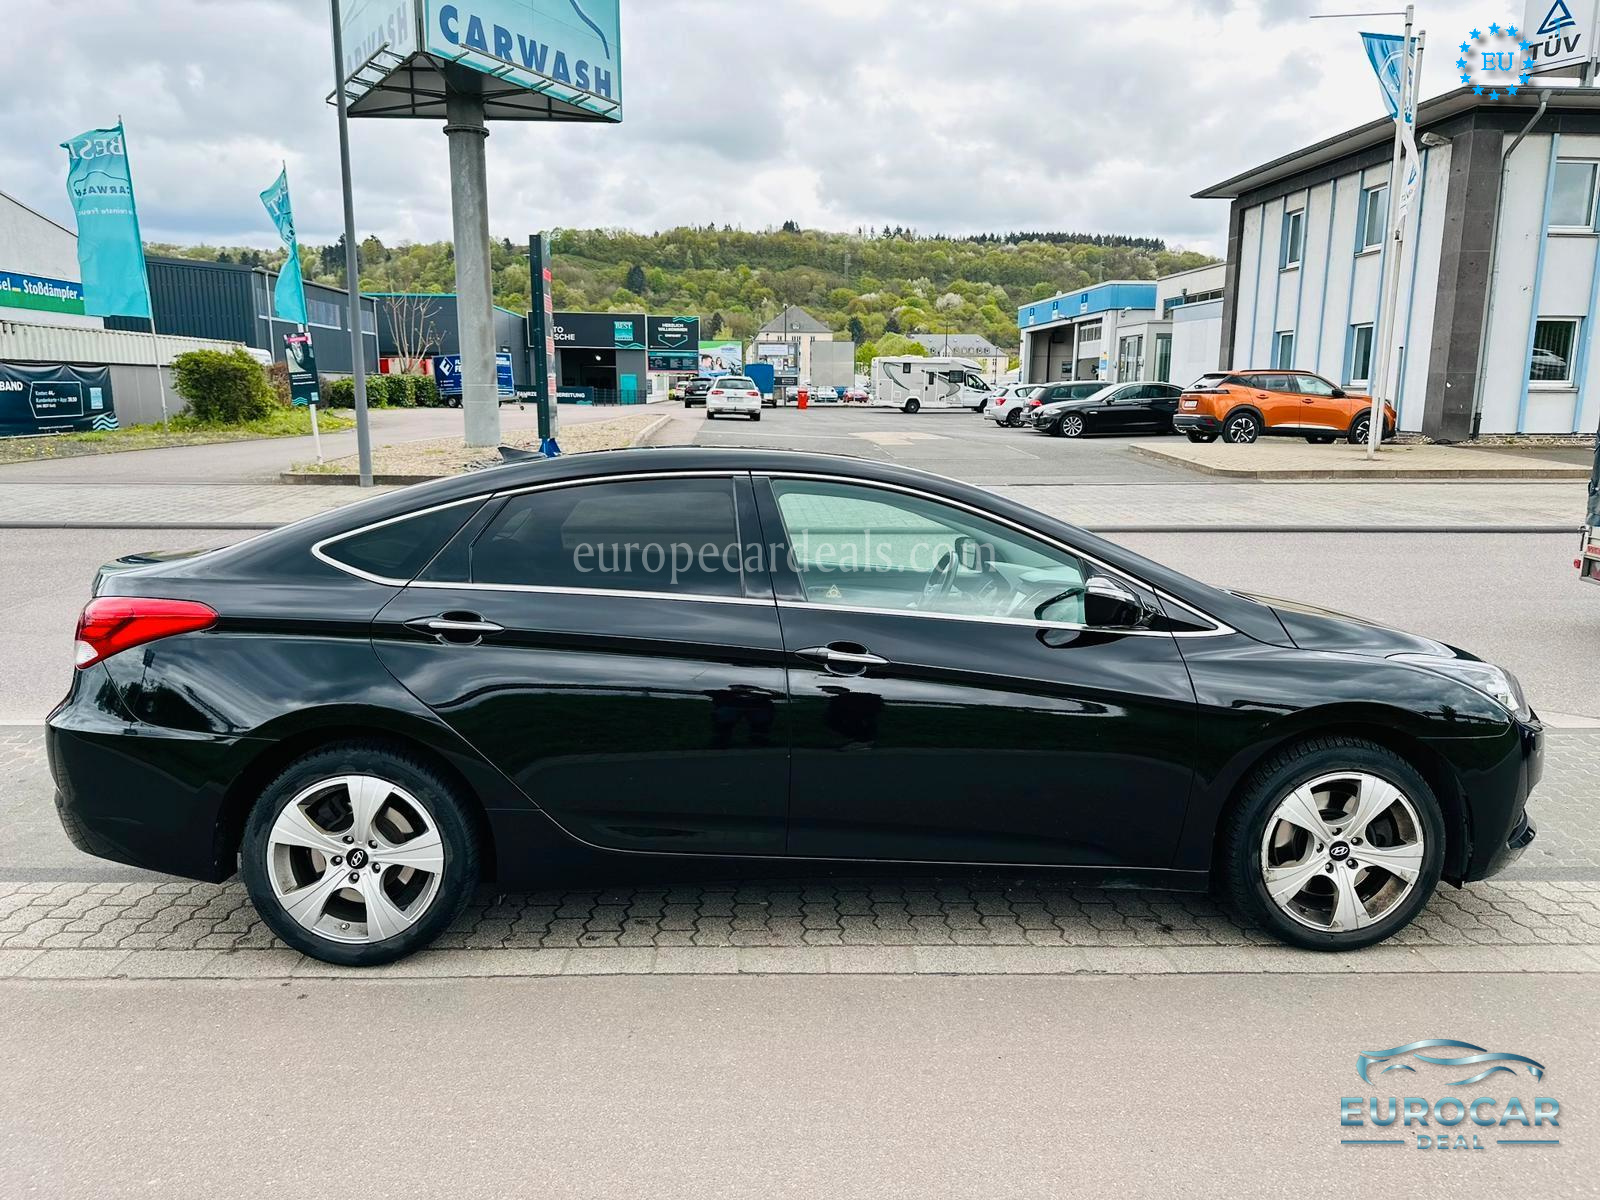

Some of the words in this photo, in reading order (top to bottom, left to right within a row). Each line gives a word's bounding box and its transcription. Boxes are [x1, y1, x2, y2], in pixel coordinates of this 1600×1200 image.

[439, 4, 612, 98] CARWASH
[1528, 33, 1582, 61] TÜV
[23, 279, 78, 302] Stoßdämpfer
[554, 333, 576, 341] SCHE
